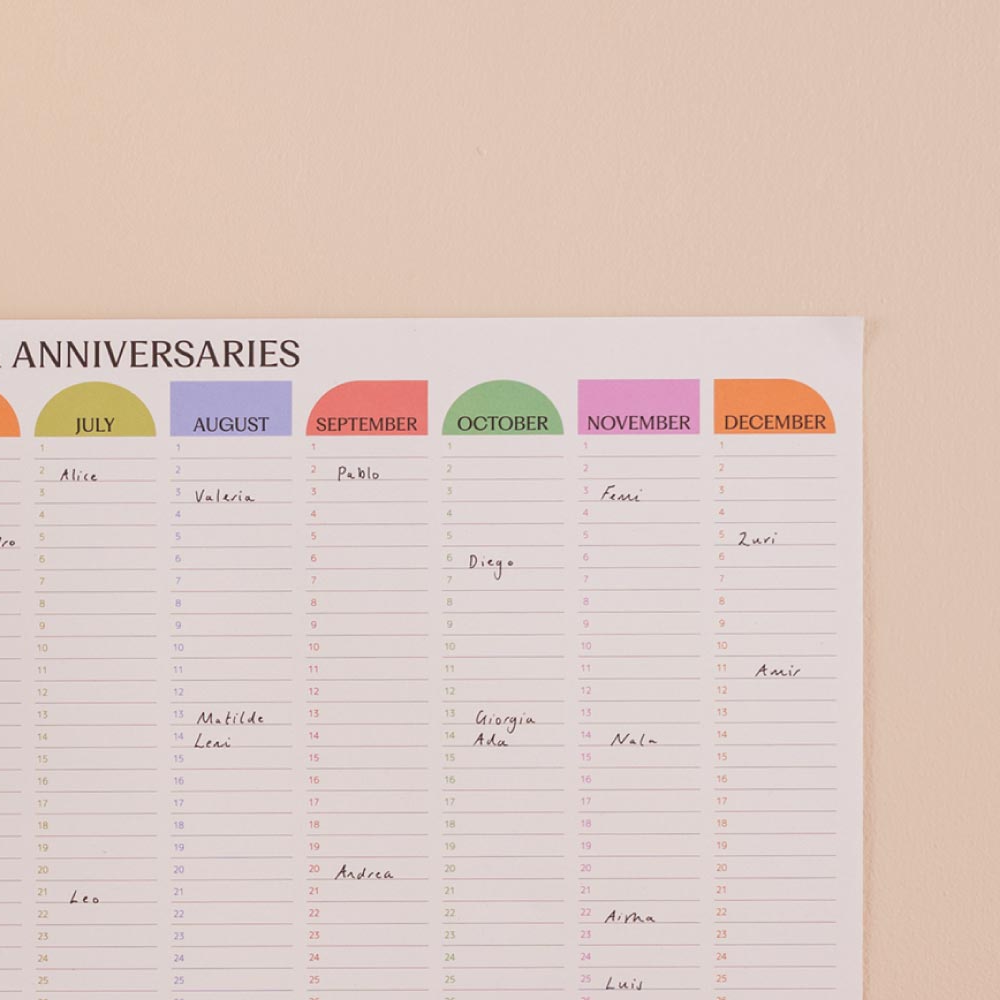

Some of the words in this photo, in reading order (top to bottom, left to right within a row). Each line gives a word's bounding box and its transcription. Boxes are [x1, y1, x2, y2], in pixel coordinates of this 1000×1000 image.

[12, 339, 300, 369] ANNIVERSARIES
[75, 417, 115, 435] JULY
[193, 416, 270, 433] AUGUST
[316, 416, 418, 432] SEPTEMBER
[457, 415, 549, 432] OCTOBER
[587, 415, 691, 431] NOVEMBER
[724, 414, 826, 430] DECEMBER
[39, 465, 45, 475] 2
[60, 468, 97, 482] Alice
[310, 464, 317, 474] 2
[337, 465, 380, 482] Pablo
[175, 487, 182, 497] 3
[195, 489, 255, 503] Valeria
[583, 485, 589, 495] 3
[601, 484, 642, 502] Femi
[718, 529, 726, 539] 5
[446, 553, 453, 562] 6
[469, 554, 514, 581] Diego
[716, 663, 727, 672] 11
[755, 663, 801, 677] Amir
[173, 709, 184, 719] 13
[196, 711, 264, 726] Matilde
[444, 708, 456, 718] 13
[475, 710, 535, 734] Giorgia
[173, 732, 184, 740] 14
[194, 733, 231, 749] Leni
[444, 731, 456, 739] 14
[474, 732, 508, 747] Ada
[580, 730, 592, 739] 14
[610, 733, 657, 747] Nala
[308, 864, 321, 873] 20
[334, 864, 394, 881] Andrea
[37, 887, 48, 897] 21
[69, 890, 100, 904] Leo
[580, 907, 592, 917] 22
[580, 974, 592, 984] 25
[605, 977, 643, 991] Luis
